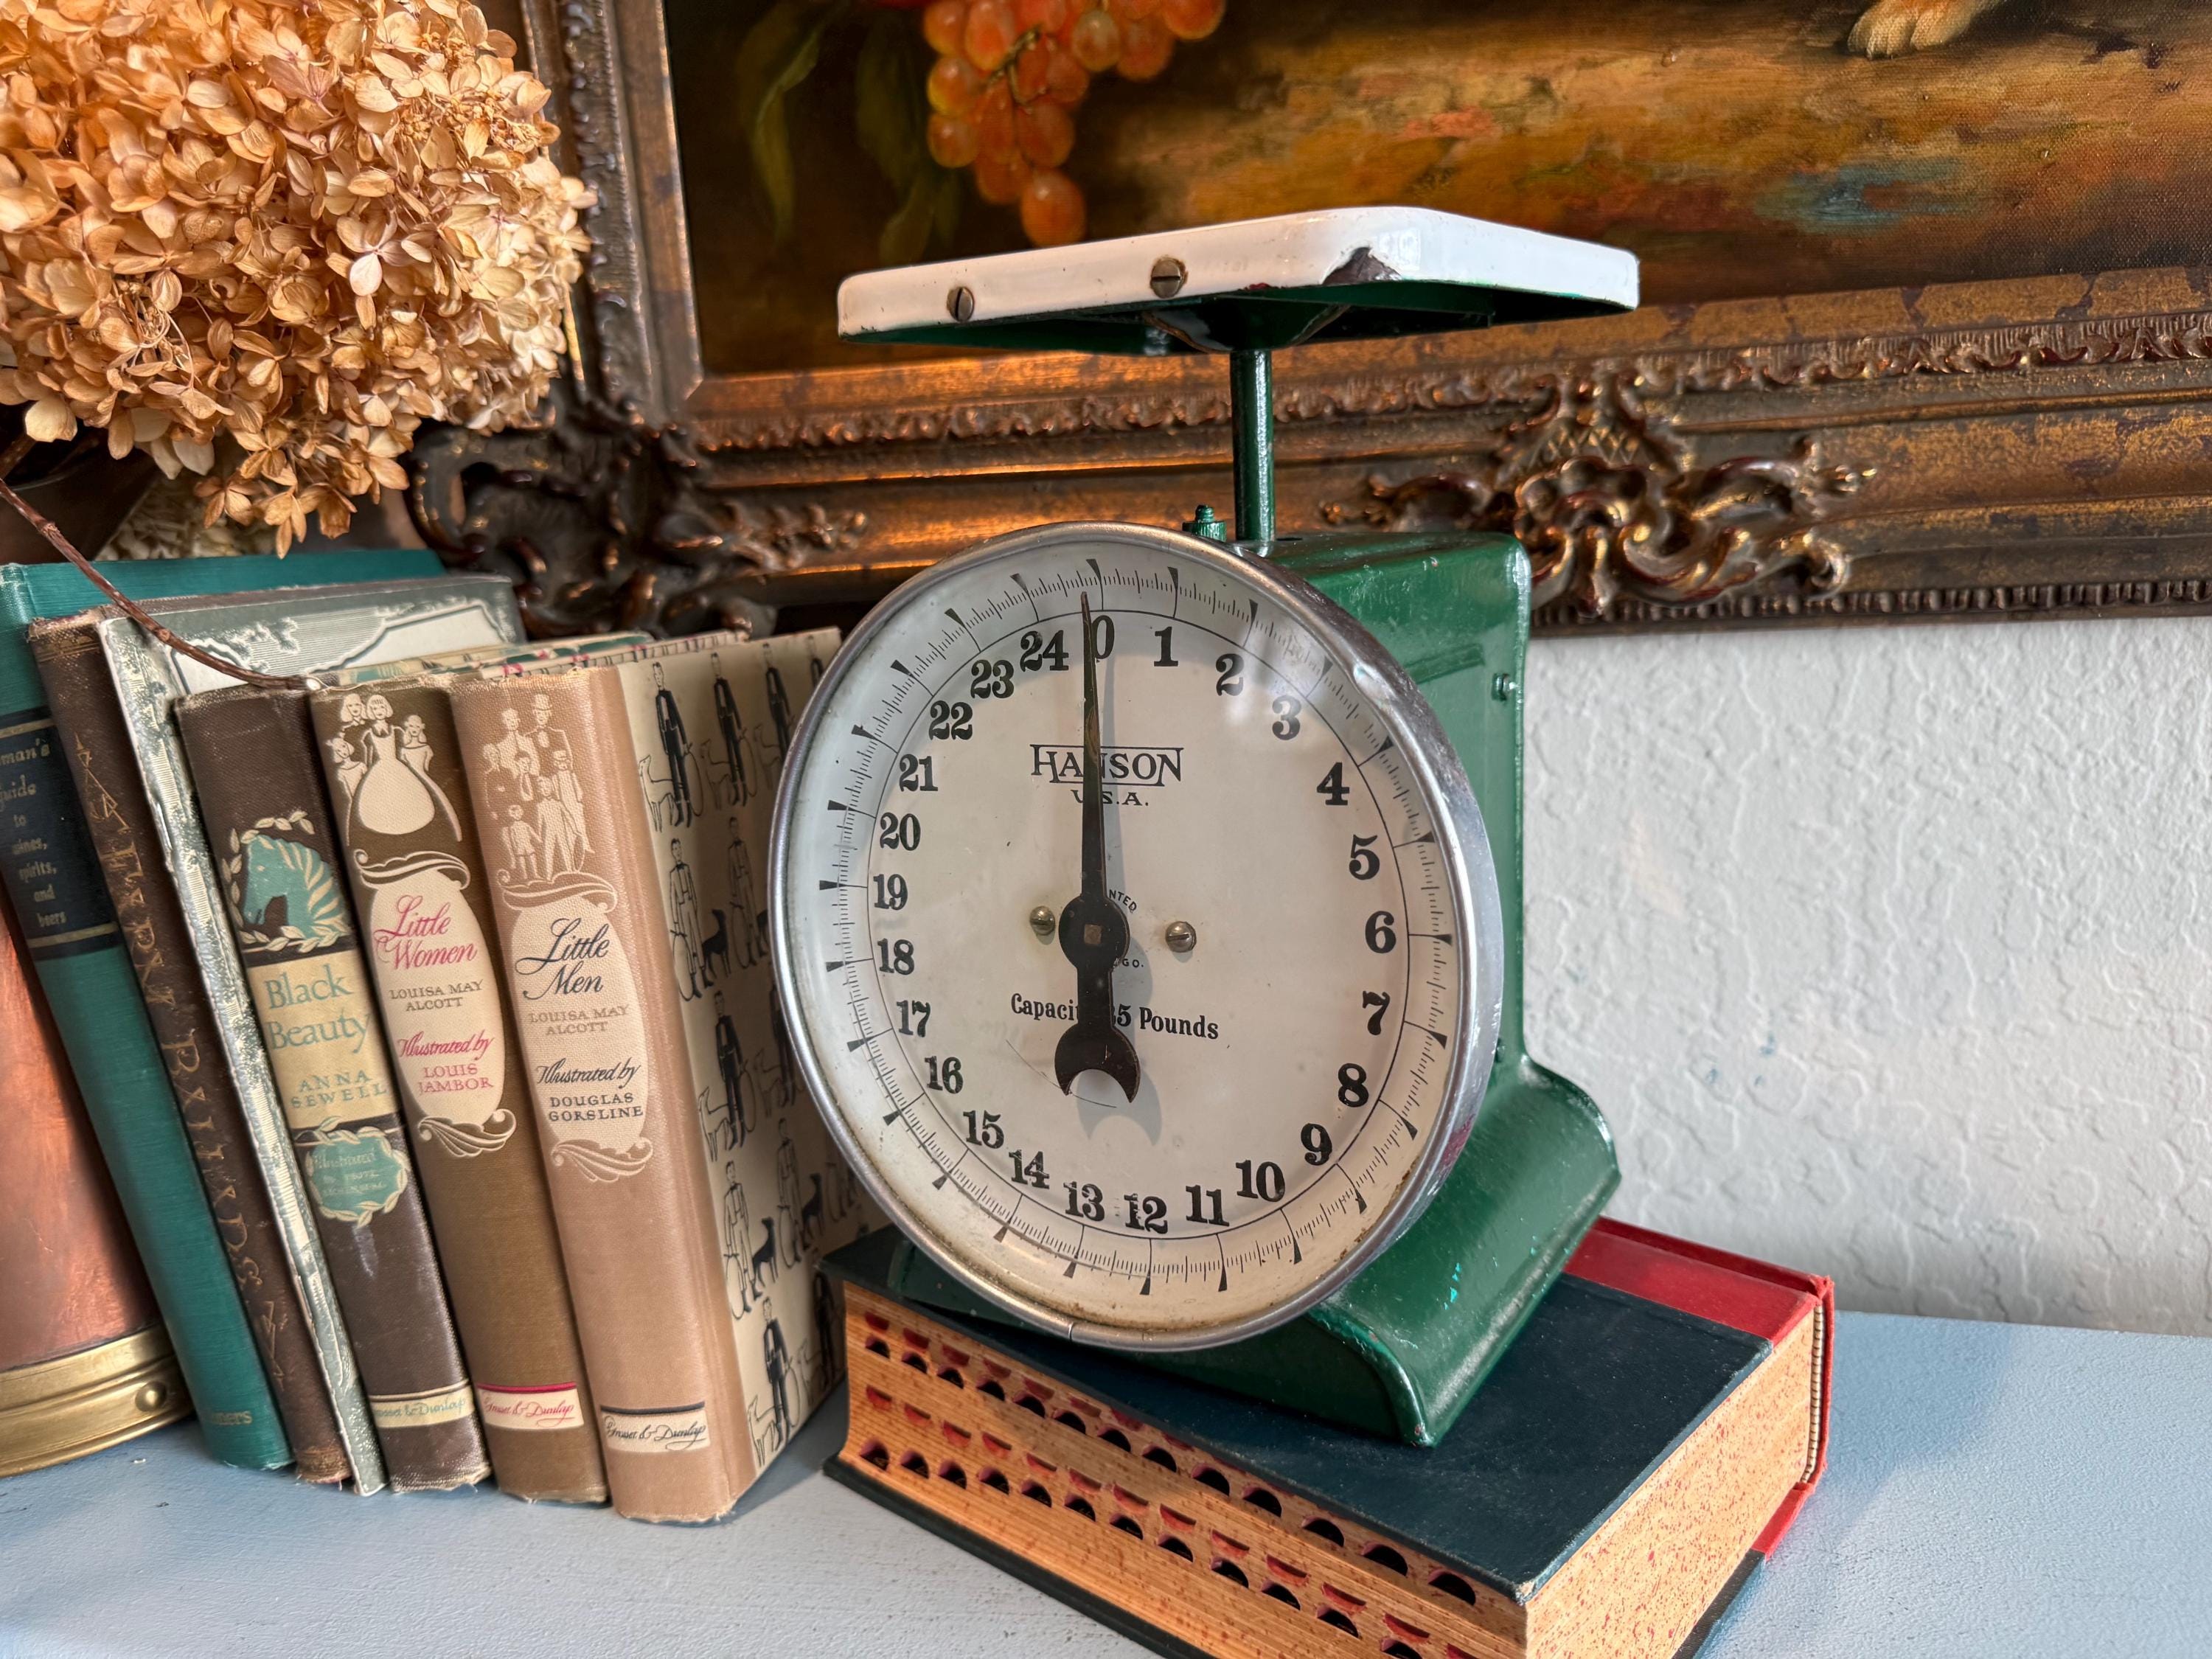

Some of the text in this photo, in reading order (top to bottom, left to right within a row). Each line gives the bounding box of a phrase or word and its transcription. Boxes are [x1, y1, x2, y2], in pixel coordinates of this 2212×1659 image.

[1020, 630, 1069, 672] 24
[1091, 615, 1115, 660] 0
[1153, 626, 1178, 667] 1
[970, 659, 1015, 698] 23
[1215, 653, 1245, 696] 2
[929, 700, 973, 740] 22
[1272, 695, 1302, 740] 3
[0, 738, 50, 765] man's
[899, 754, 938, 792] 21
[1316, 762, 1349, 805] 4
[1071, 789, 1149, 806] US.A.
[880, 813, 921, 851] 20
[1349, 834, 1380, 880] 5
[34, 883, 56, 902] and
[873, 874, 908, 911] 19
[1109, 889, 1137, 912] NTED
[375, 894, 452, 939] Little
[1365, 911, 1397, 953] 6
[375, 934, 478, 970] Women
[515, 917, 611, 975] Little
[877, 938, 914, 975] 18
[264, 963, 354, 1010] Black
[389, 979, 484, 1000] LOUISA MAY
[523, 961, 604, 1001] Men
[406, 997, 464, 1012] ALCOTT
[529, 1004, 630, 1024] LOUISA MAY
[897, 1000, 931, 1037] 17
[1011, 993, 1079, 1021] Capaci
[1139, 1006, 1220, 1040] Pounds
[1362, 991, 1391, 1035] 7
[267, 1007, 370, 1054] Beauty
[397, 1029, 495, 1061] Illustrated by
[546, 1020, 610, 1034] ALCOTT
[298, 1071, 372, 1093] ANNA
[418, 1077, 495, 1095] JAMBOR
[422, 1062, 479, 1079] LOUIS
[536, 1056, 641, 1090] Illustrated by
[925, 1056, 964, 1094] 16
[1338, 1062, 1369, 1107] 8
[291, 1082, 388, 1109] SEWELL
[548, 1106, 644, 1122] GORSLINE
[550, 1093, 635, 1108] DOUGLAS
[963, 1110, 1004, 1149] 15
[1301, 1123, 1333, 1166] 9
[1009, 1150, 1050, 1189] 14
[1235, 1160, 1286, 1202] 10
[1063, 1181, 1105, 1221] 13
[1124, 1193, 1169, 1234] 12
[1186, 1185, 1230, 1227] 11
